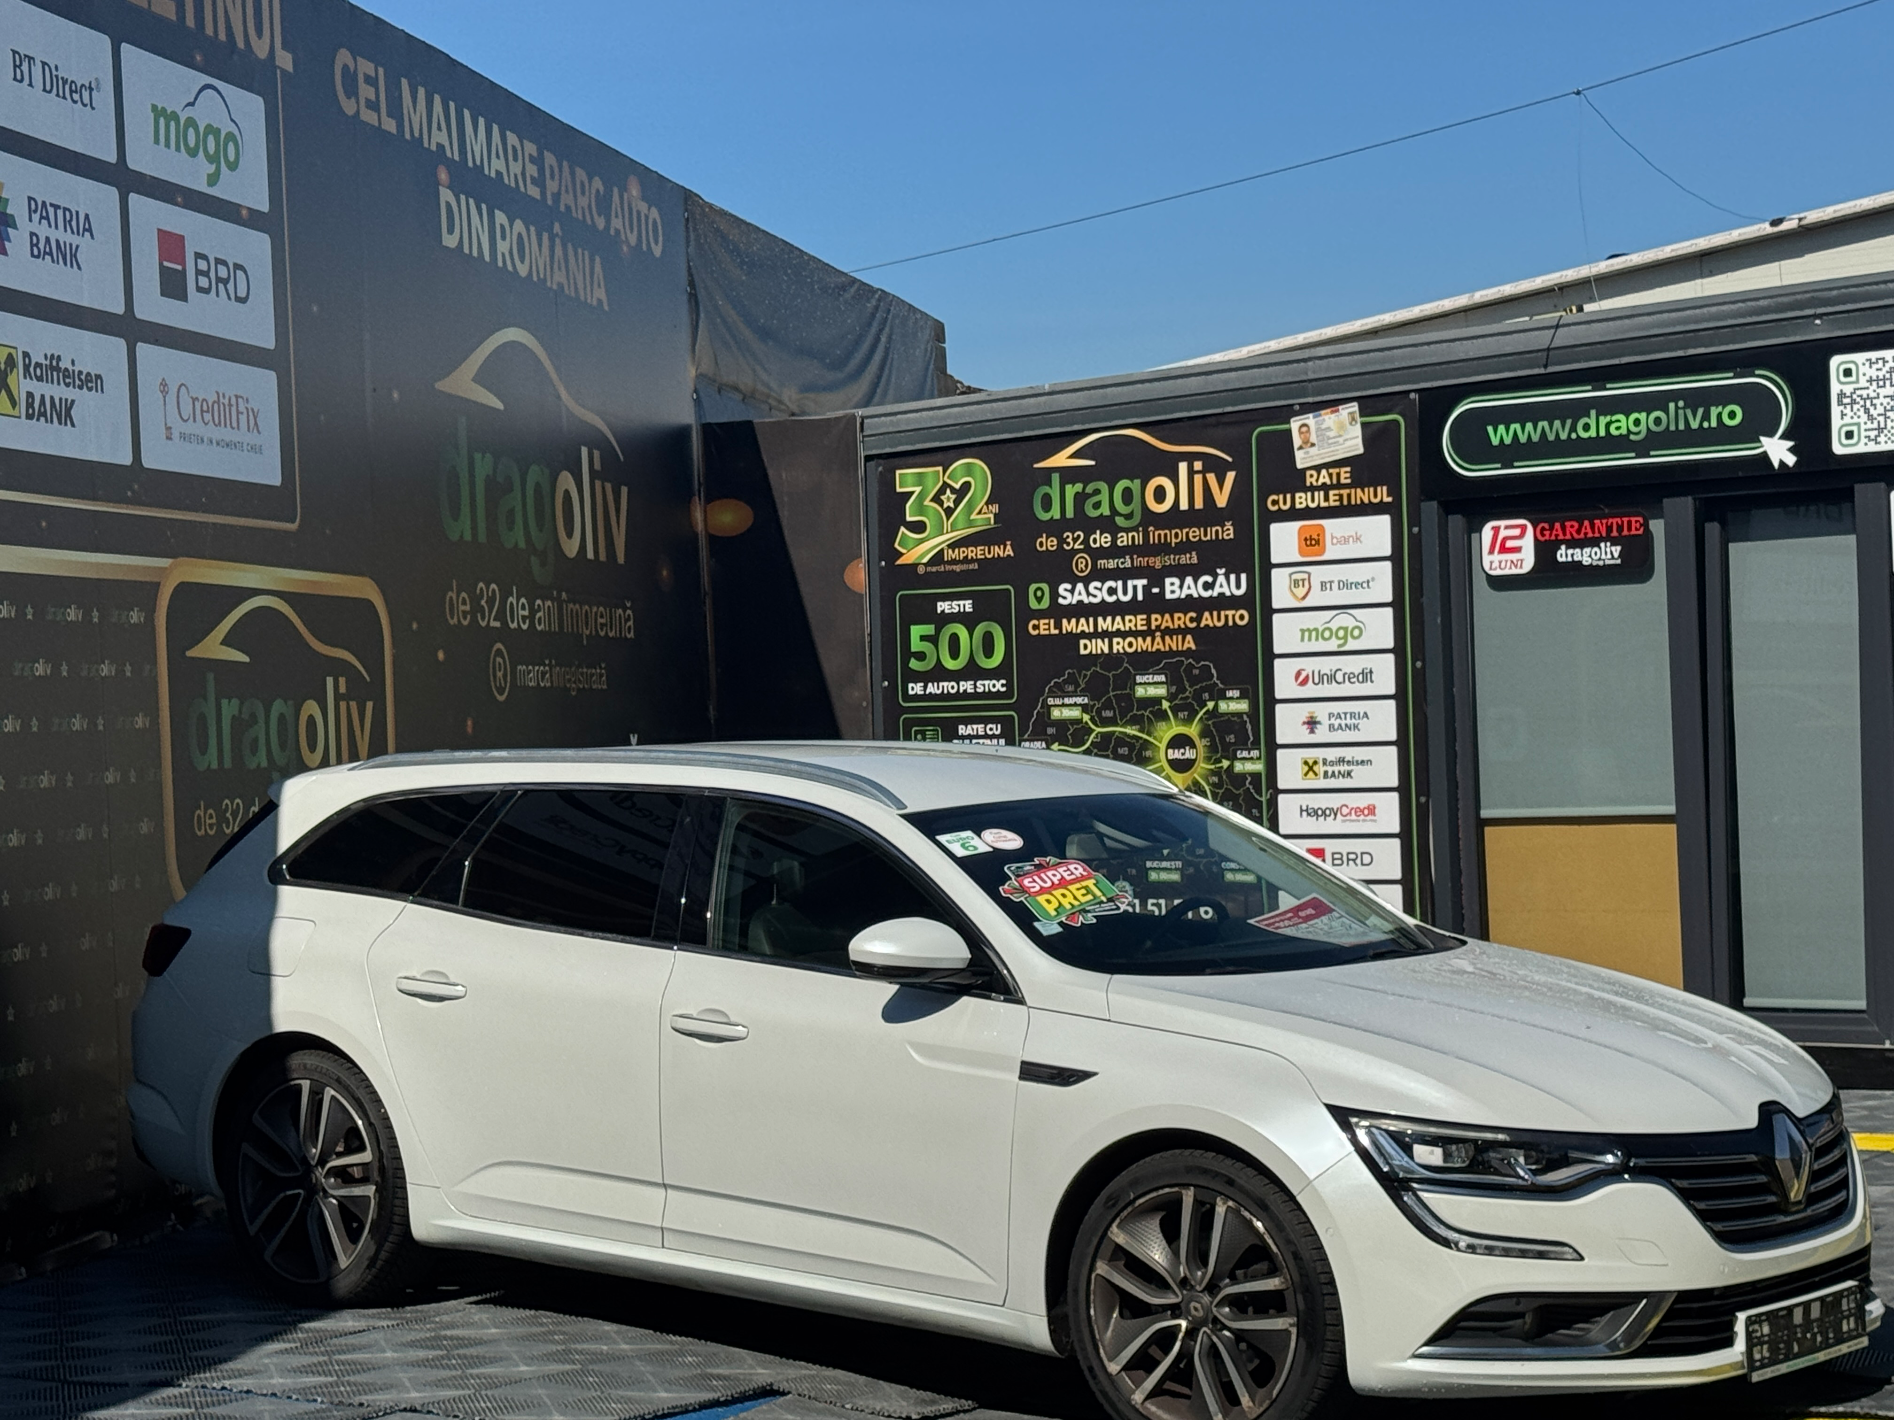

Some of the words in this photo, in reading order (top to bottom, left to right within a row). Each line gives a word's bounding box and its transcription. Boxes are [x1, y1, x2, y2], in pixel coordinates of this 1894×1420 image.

[10, 49, 36, 89] BT
[151, 103, 241, 187] mogo
[334, 48, 396, 135] CEL
[400, 77, 459, 161] MAI
[464, 108, 540, 200] MARE
[543, 149, 605, 231] PARC
[610, 186, 663, 258] AUTO
[27, 195, 95, 241] PATRIA
[28, 231, 82, 271] BANK
[438, 186, 490, 263] DIN
[494, 209, 609, 312] ROMÂNIA
[194, 251, 250, 304] BRD
[22, 351, 104, 394] Raiffeisen
[25, 393, 76, 428] BANK
[176, 383, 261, 435] CreditFix
[1487, 400, 1743, 446] www.dragoliv.ro
[179, 431, 205, 446] PRIETEN
[206, 435, 213, 447] IN
[215, 436, 245, 453] MOMENTE
[246, 440, 263, 455] CHEIE
[1305, 467, 1351, 486] RATE
[439, 415, 628, 585] dragoliv
[895, 458, 992, 553] 32
[1033, 461, 1236, 527] dragoliv
[1267, 493, 1291, 511] CU
[1295, 486, 1392, 509] BULETINUL
[982, 503, 999, 514] ANI
[1036, 534, 1056, 550] de
[1063, 532, 1084, 549] 32
[1090, 530, 1112, 548] de
[1117, 528, 1143, 546] ani
[1148, 522, 1234, 546] împreună
[1304, 533, 1321, 548] tbi
[1331, 532, 1362, 546] bank
[1487, 524, 1528, 556] 12
[1535, 516, 1644, 541] GARANTIE
[944, 541, 1014, 561] ÎMPREUNĂ
[1097, 556, 1132, 570] marcă
[1134, 552, 1198, 569] înregistrată
[1556, 542, 1622, 565] dragoliv
[1488, 558, 1526, 571] LUNI
[1058, 579, 1147, 605] SASCUT
[1164, 568, 1248, 600] BACĂU
[1293, 577, 1307, 589] BT
[1320, 580, 1335, 592] BT
[445, 579, 470, 625] de
[476, 582, 500, 627] 32
[507, 586, 529, 630] de
[535, 591, 558, 632] ani
[562, 592, 635, 645] împreună
[937, 600, 973, 613] PESTE
[1028, 618, 1059, 635] CEL
[1062, 617, 1095, 634] MAI
[1098, 614, 1147, 632] MARE
[1151, 611, 1197, 630] PARC
[1200, 609, 1250, 627] AUTO
[908, 621, 1006, 671] 500
[1079, 638, 1110, 655] DIN
[1113, 633, 1196, 654] ROMÂNIA
[1299, 624, 1364, 648] mogo
[517, 660, 551, 687] marcă
[551, 662, 608, 695] înregistrată
[908, 682, 924, 694] DE
[926, 681, 958, 694] AUTO
[960, 681, 974, 693] PE
[976, 679, 1007, 693] STOC
[1136, 674, 1166, 683] SUCEAVA
[1312, 667, 1374, 686] UniCredit
[1047, 696, 1089, 705] CLUJ-NAPOCA
[189, 671, 374, 784] dragoliv
[1328, 711, 1369, 721] PATRIA
[1328, 722, 1361, 733] BANK
[958, 724, 984, 736] RATE
[986, 723, 1002, 735] CU
[1167, 746, 1196, 760] BACĂU
[1322, 756, 1372, 768] Raiffeisen
[1322, 769, 1354, 780] BANK
[193, 800, 217, 837] de
[221, 798, 243, 834] 32
[1300, 803, 1377, 821] HappyCredit
[946, 836, 974, 845] EURO
[960, 841, 978, 852] 6
[1146, 860, 1182, 869] BUCUREȘTI
[1331, 852, 1374, 867] BRD
[1023, 861, 1088, 893] SUPER
[1036, 878, 1107, 916] PREȚ
[1147, 898, 1167, 916] 51
